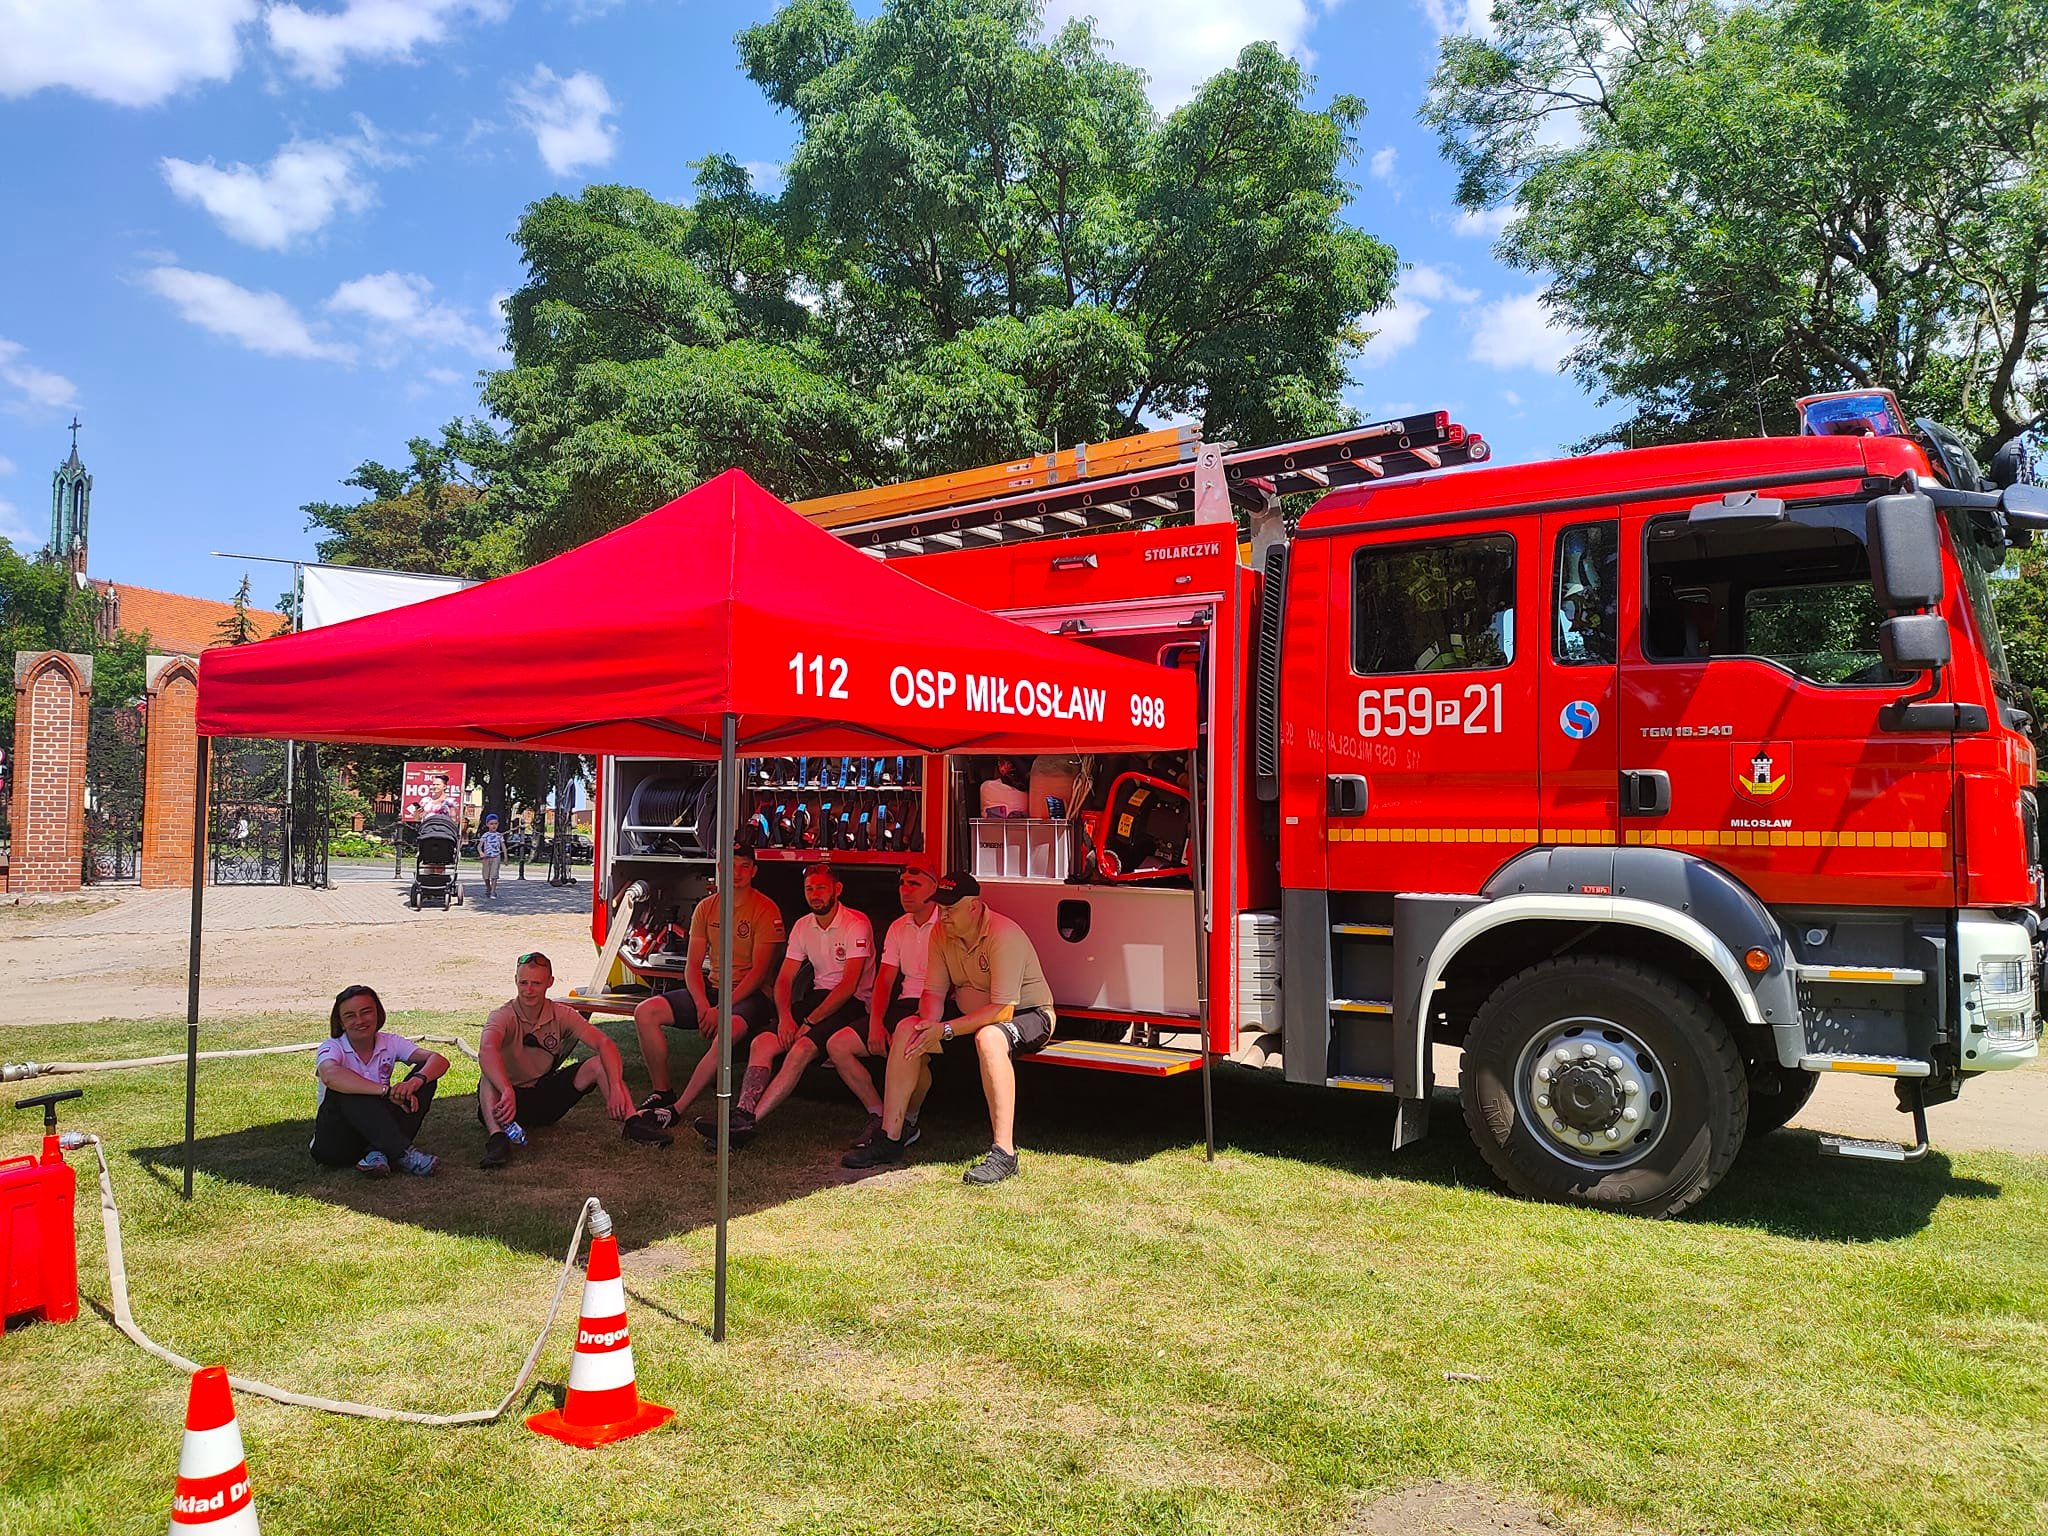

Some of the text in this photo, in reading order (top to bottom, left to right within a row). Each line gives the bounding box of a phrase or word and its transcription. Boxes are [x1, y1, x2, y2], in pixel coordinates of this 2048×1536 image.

[1144, 542, 1220, 562] STOLARCZYK
[788, 652, 1165, 730] 112 OSP MIŁOSŁAW 998
[1640, 725, 1733, 737] TGM 18.340
[1730, 819, 1793, 828] MIŁOSŁAW
